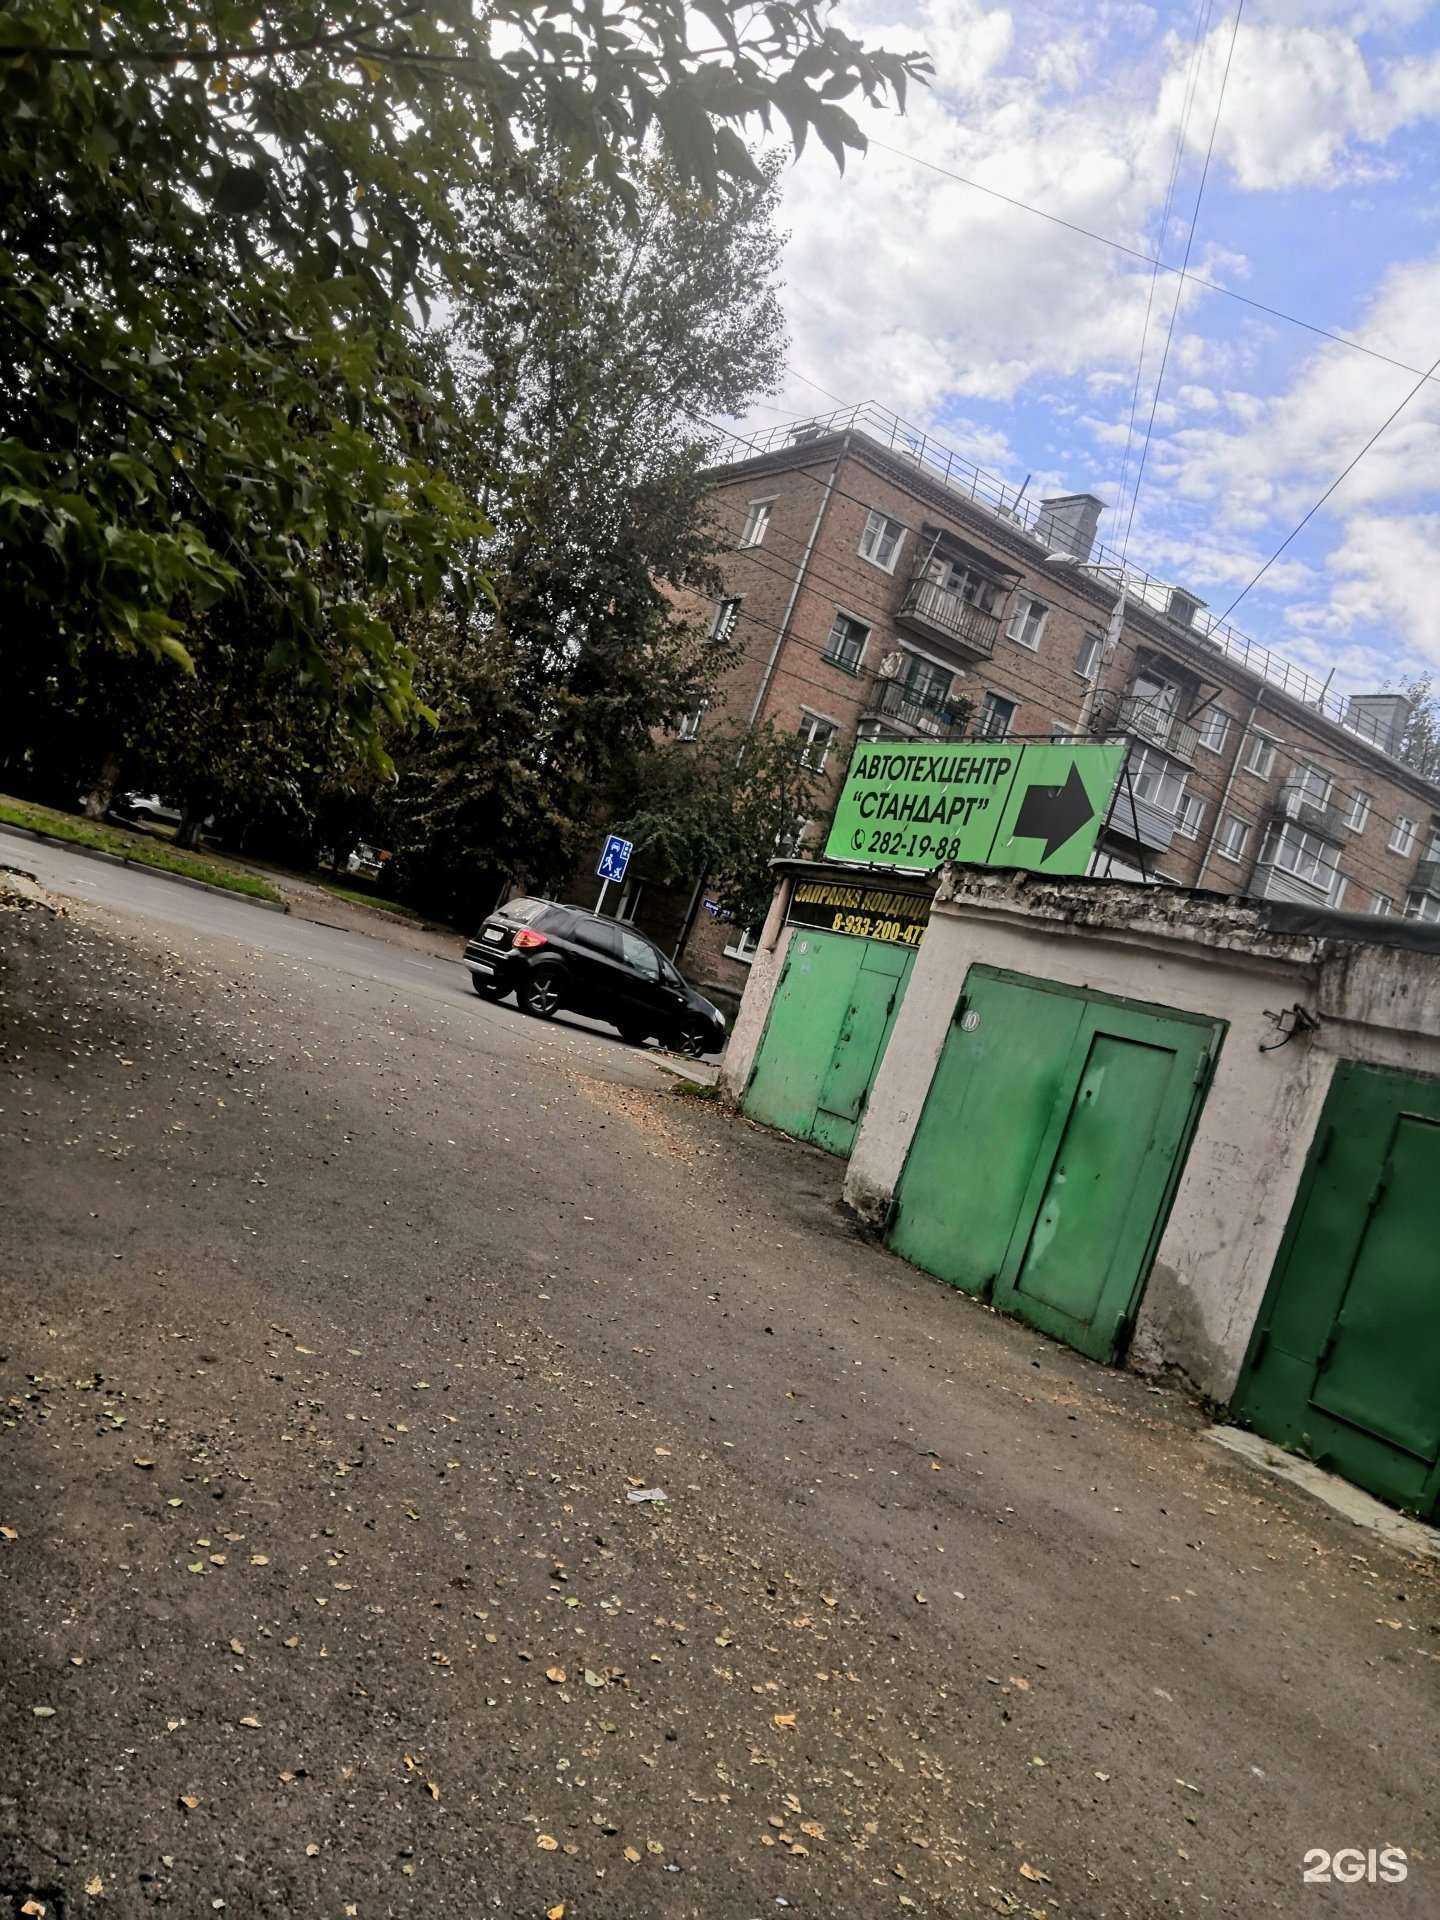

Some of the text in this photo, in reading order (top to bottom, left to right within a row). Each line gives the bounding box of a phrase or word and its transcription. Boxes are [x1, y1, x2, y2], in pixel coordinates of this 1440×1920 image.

[853, 755, 1011, 784] АВТОТЕХЦЕНТР
[868, 830, 961, 860] 282-19-88
[795, 883, 862, 908] ЗАПРАВКА
